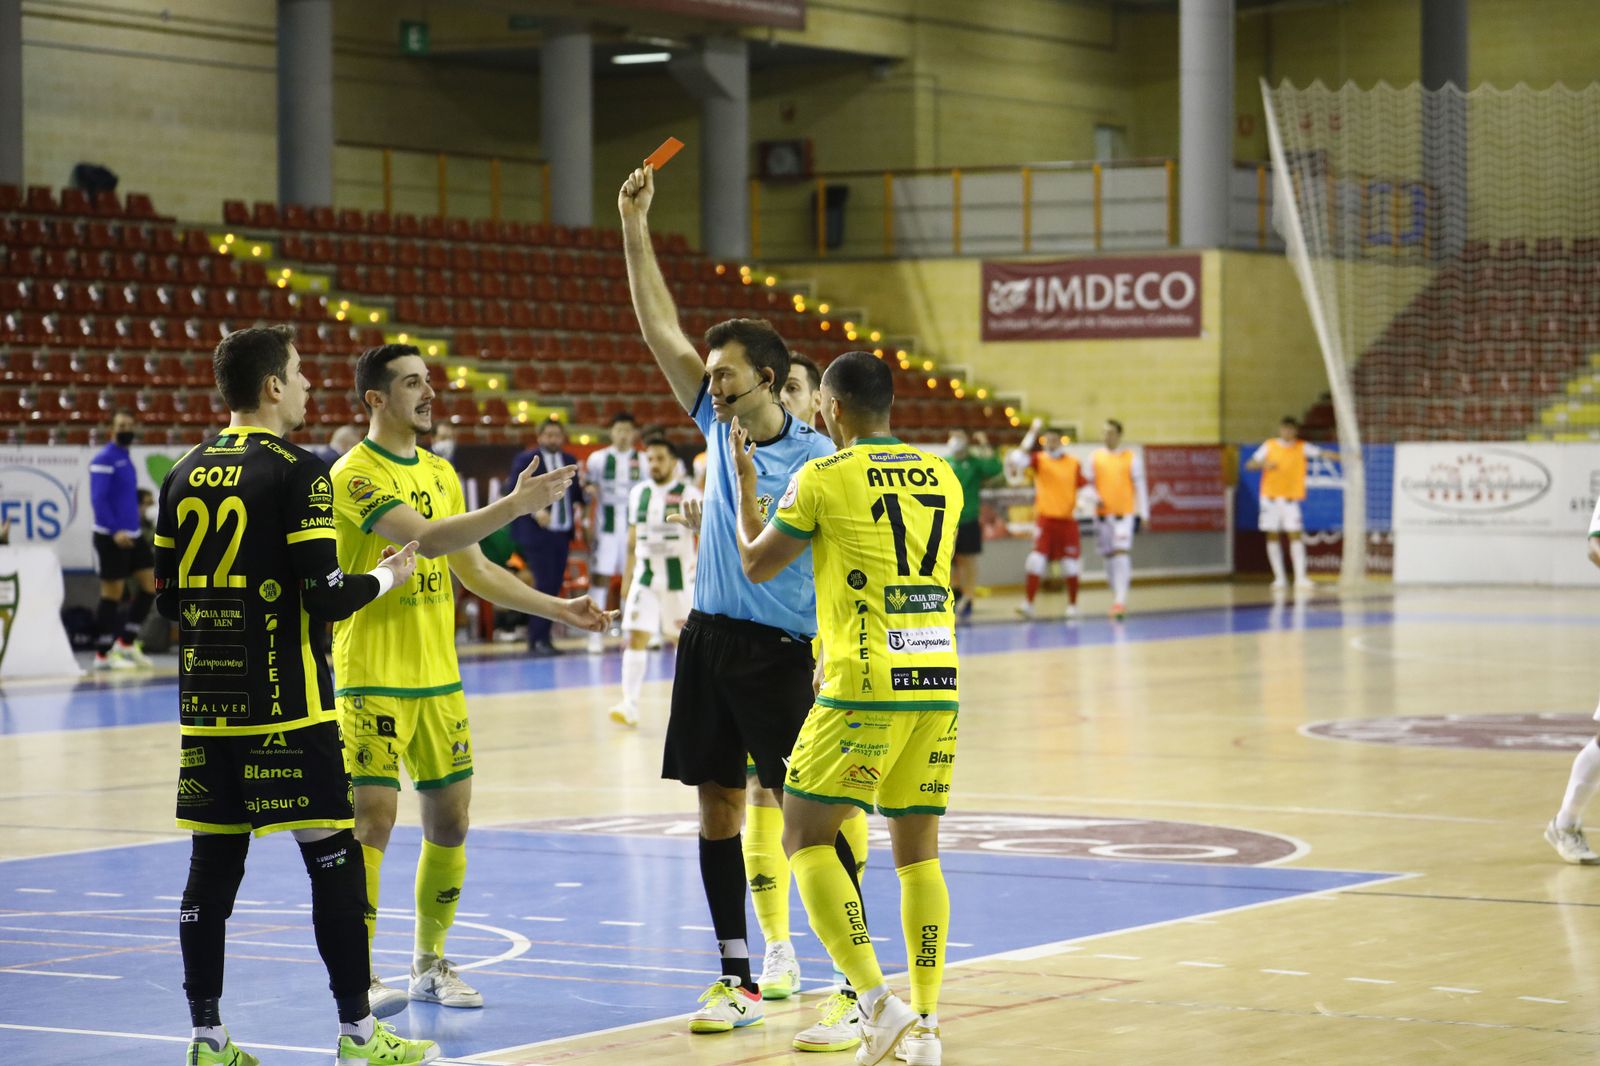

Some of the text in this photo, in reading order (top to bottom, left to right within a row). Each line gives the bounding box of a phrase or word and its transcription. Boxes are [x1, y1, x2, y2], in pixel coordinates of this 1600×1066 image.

[1034, 271, 1195, 313] IMDECO
[188, 465, 243, 488] GOZI
[867, 467, 939, 488] ATTOS
[176, 495, 248, 589] 22
[870, 492, 946, 577] 17
[220, 609, 243, 618] RURAL
[267, 634, 282, 716] IFEJA
[858, 617, 872, 691] IFEJA
[244, 764, 303, 779] Blanca
[844, 901, 871, 946] Blanca
[915, 924, 939, 968] Blanca
